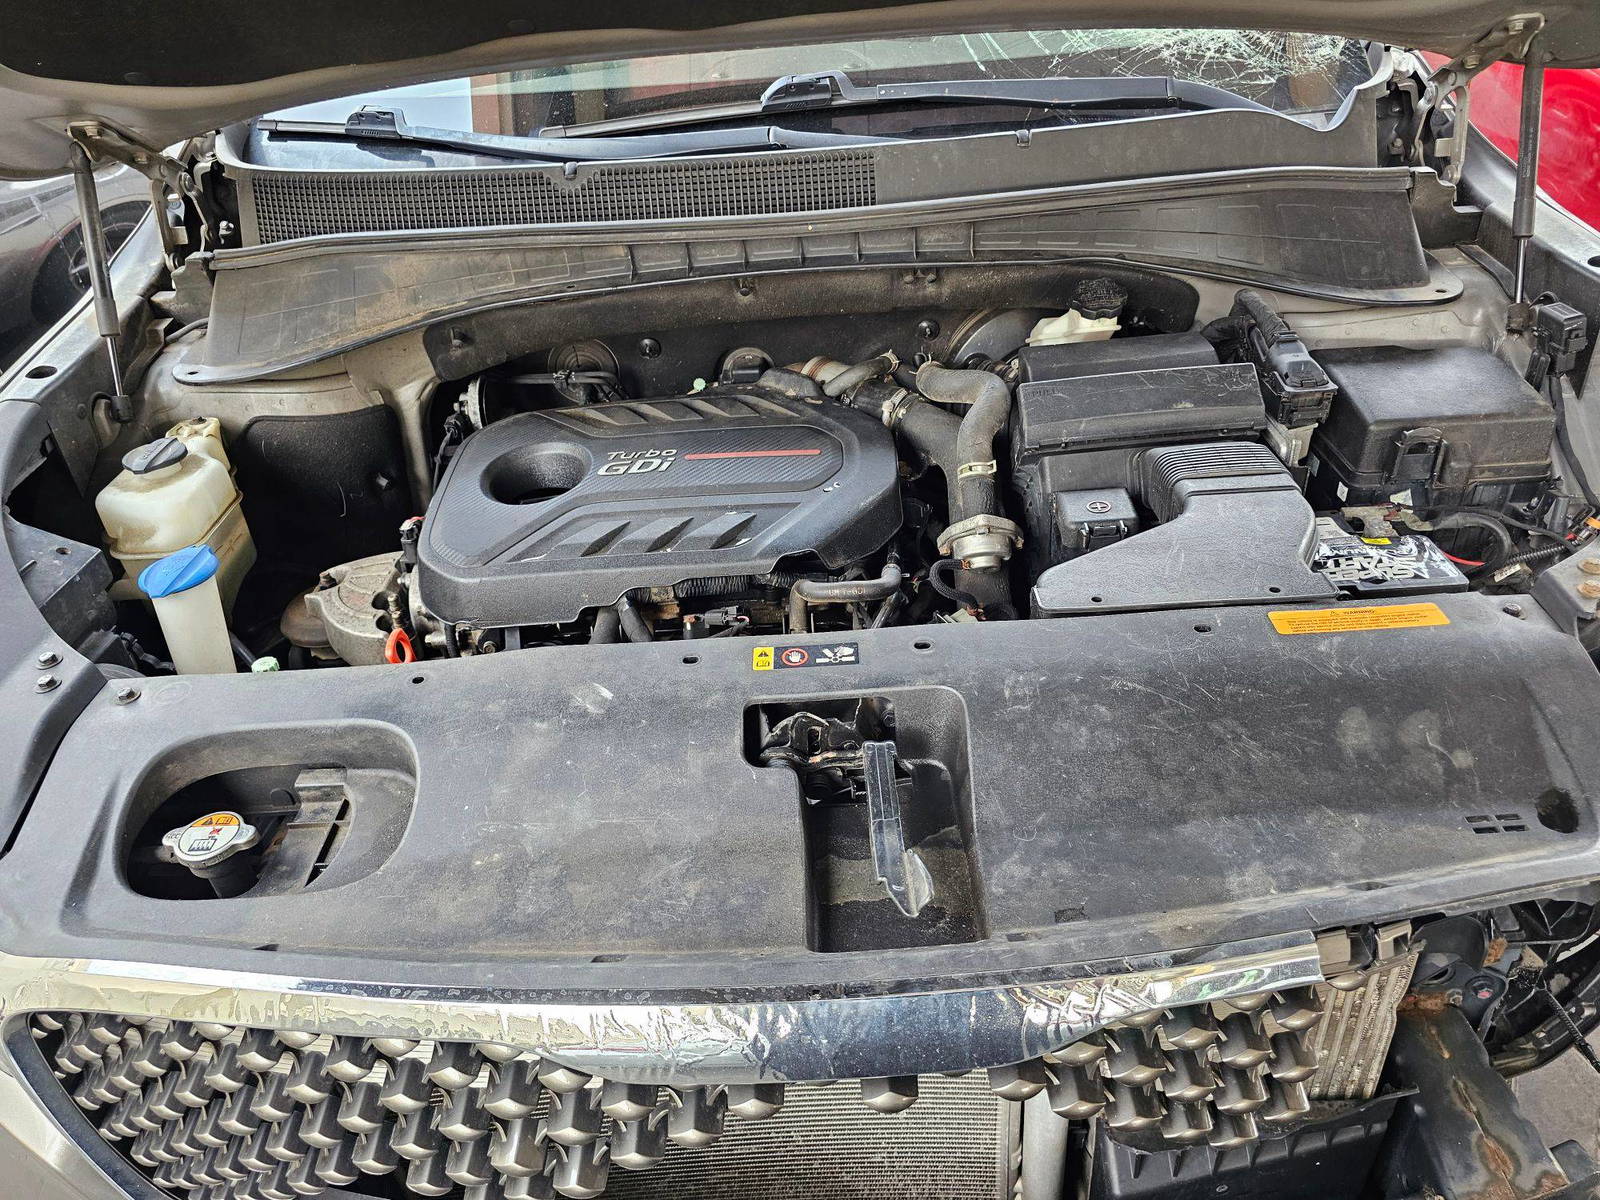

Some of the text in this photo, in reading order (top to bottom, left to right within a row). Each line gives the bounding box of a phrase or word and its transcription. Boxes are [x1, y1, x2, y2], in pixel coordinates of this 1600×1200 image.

[607, 449, 677, 460] Turbo
[597, 457, 676, 475] GDi
[1325, 567, 1414, 580] SUPER
